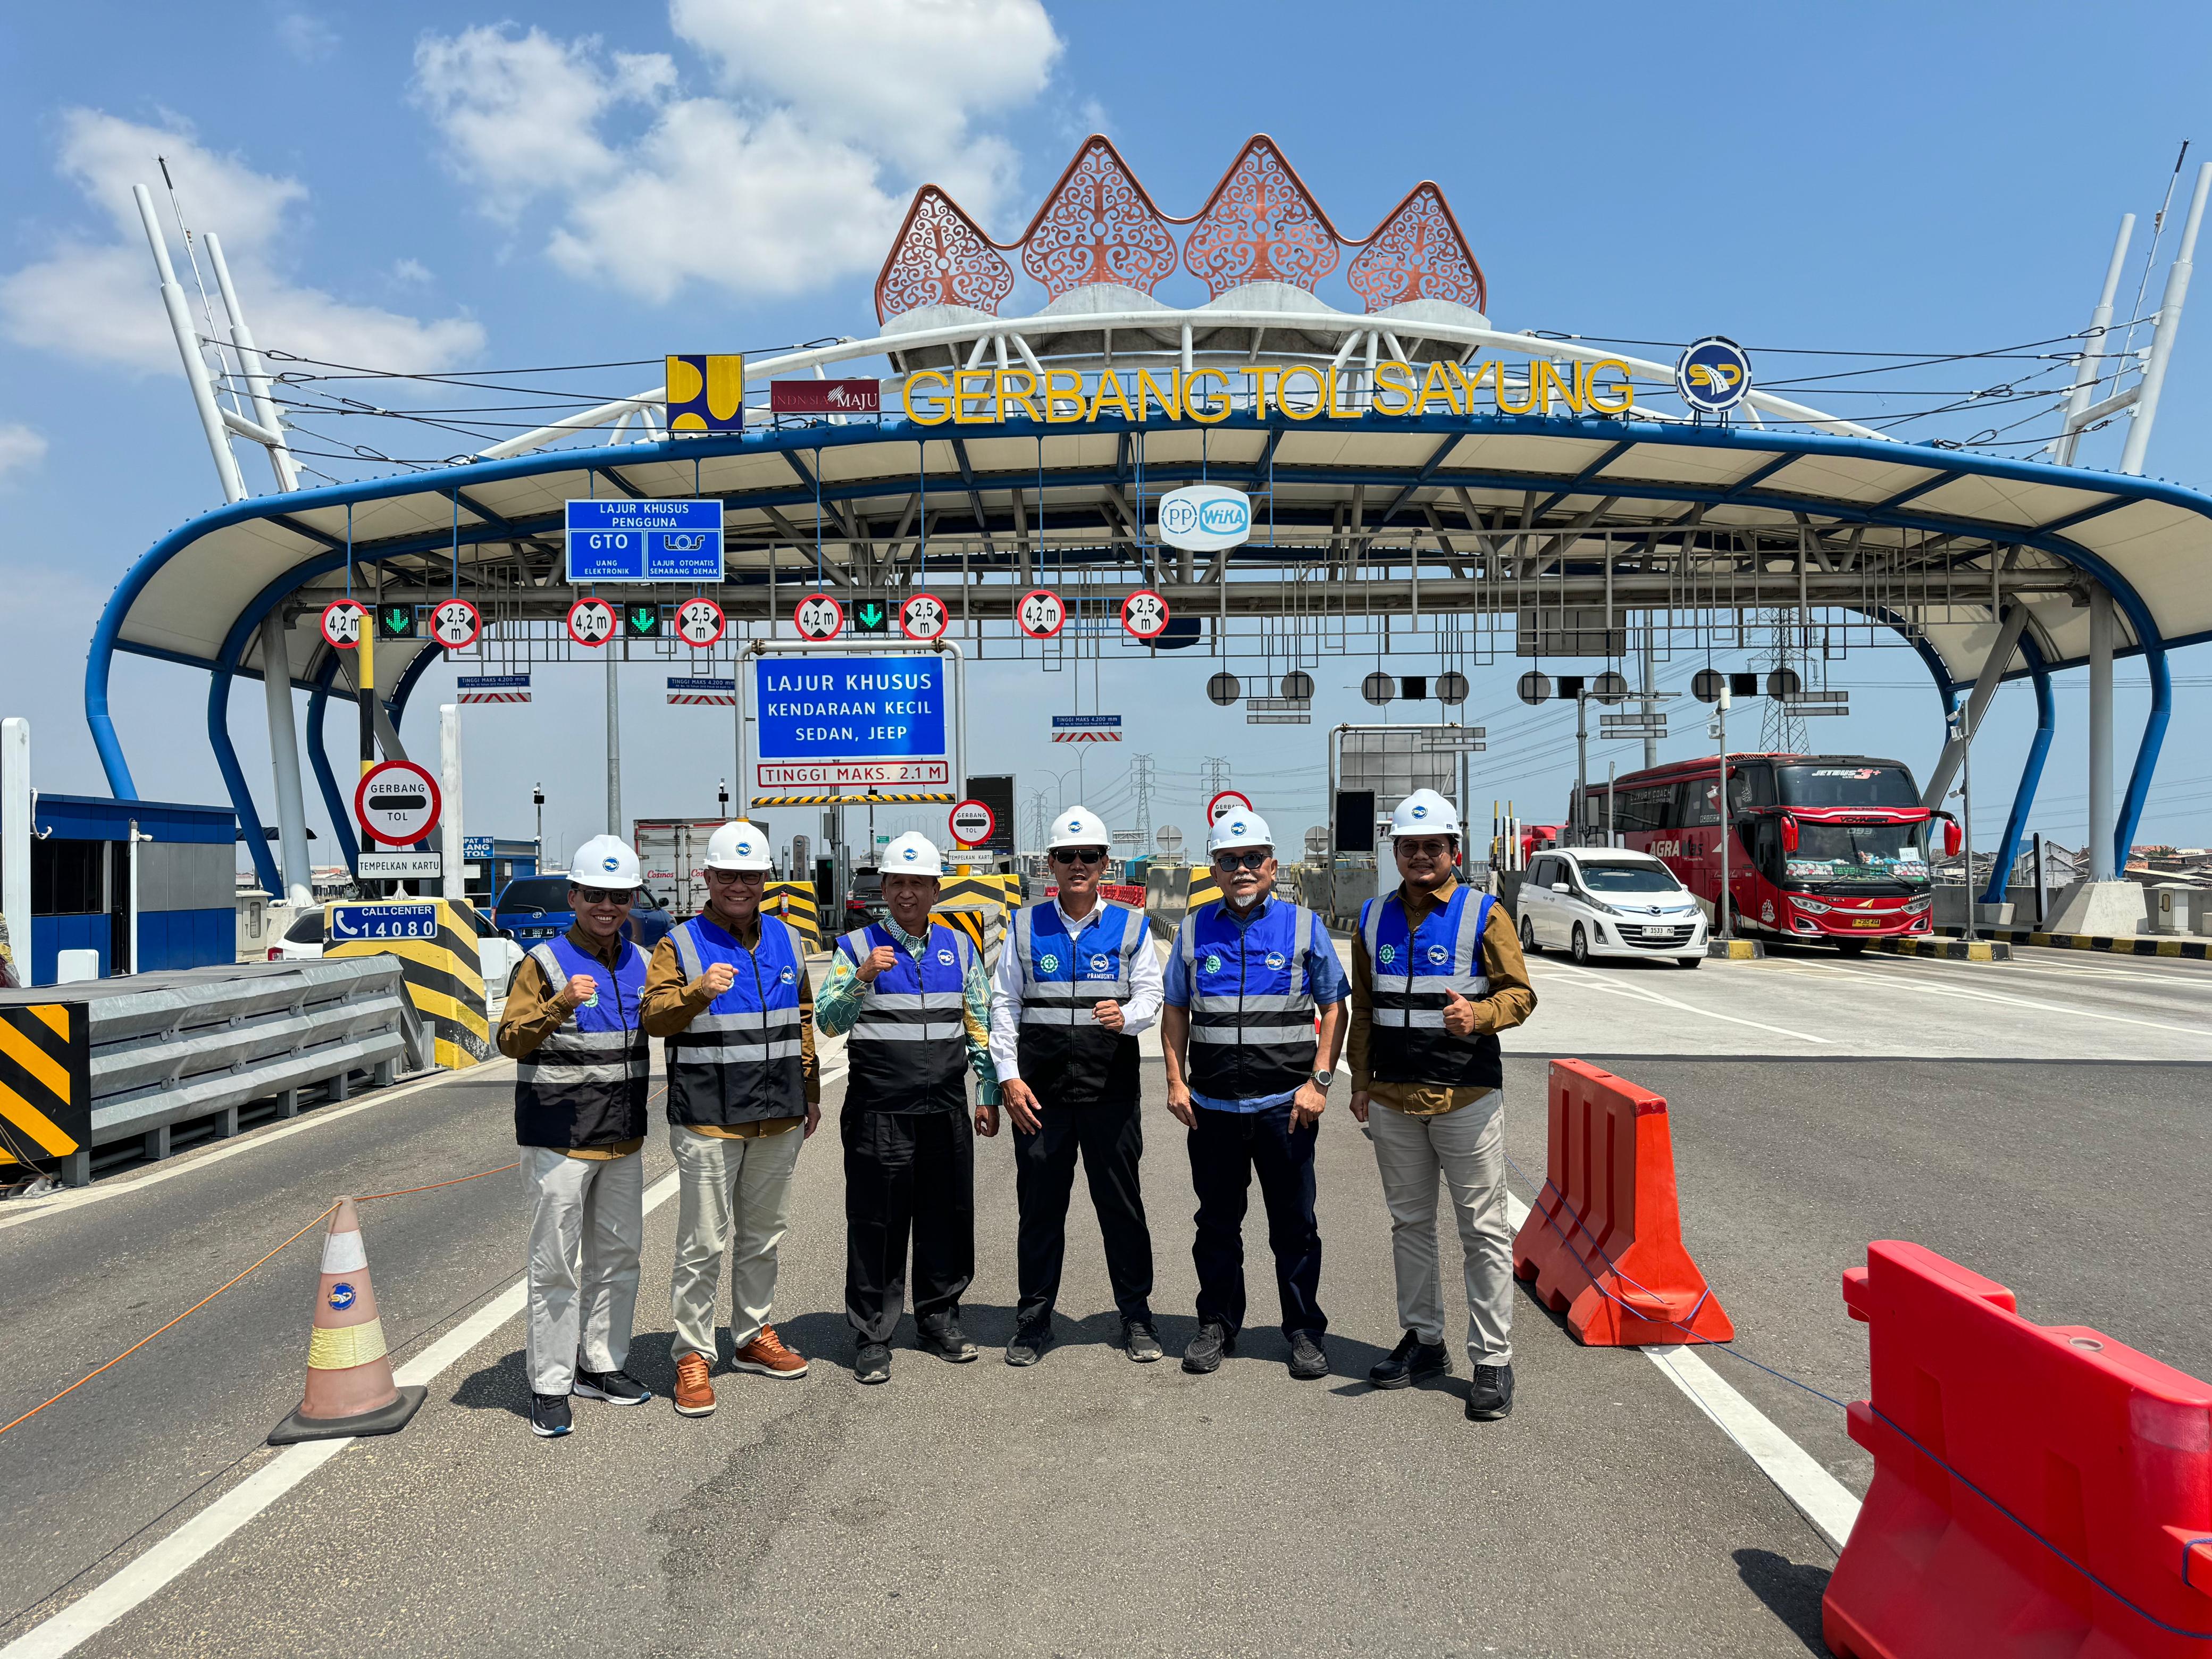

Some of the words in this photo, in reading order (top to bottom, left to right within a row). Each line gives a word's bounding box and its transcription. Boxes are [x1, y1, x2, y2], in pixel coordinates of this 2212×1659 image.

[903, 367, 1232, 425] GERBANG
[1238, 364, 1363, 421] TOL
[1372, 358, 1635, 416] SAYUNG
[837, 393, 877, 410] MAJU
[600, 504, 636, 513] LAJUR
[644, 504, 689, 513] KHUSUS
[612, 517, 677, 527] PENGGUNA
[589, 534, 628, 549] GTO
[915, 602, 933, 619] 2,5
[1026, 606, 1042, 624] 4,2
[1046, 608, 1055, 621] m
[1137, 599, 1154, 616] 2,5
[447, 608, 465, 625] 2,5
[576, 614, 593, 632] 4,2
[597, 615, 607, 629] m
[691, 607, 710, 624] 2,5
[803, 611, 820, 629] 4,2
[824, 612, 833, 625] m
[329, 616, 346, 634] 4,2
[920, 621, 929, 633] m
[1141, 618, 1150, 630] m
[451, 627, 461, 640] m
[696, 626, 705, 639] m
[767, 675, 834, 691] LAJUR
[846, 673, 931, 690] KHUSUS
[768, 702, 875, 716] KENDARAAN
[885, 701, 932, 714] KECIL
[795, 727, 859, 741] SEDAN,
[868, 726, 907, 740] JEEP
[766, 768, 826, 782] TINGGI
[837, 767, 890, 781] MAKS.
[900, 767, 921, 780] 2.1
[929, 766, 941, 778] M
[371, 784, 425, 793] GERBANG
[1653, 789, 1671, 798] COACH
[1649, 840, 1680, 857] AGRA
[359, 861, 407, 870] TEMPELKAN
[413, 861, 439, 869] KARTU
[647, 870, 674, 878] Cosmos
[362, 907, 389, 916] CALL
[390, 906, 432, 915] CENTER
[362, 921, 433, 937] 14080
